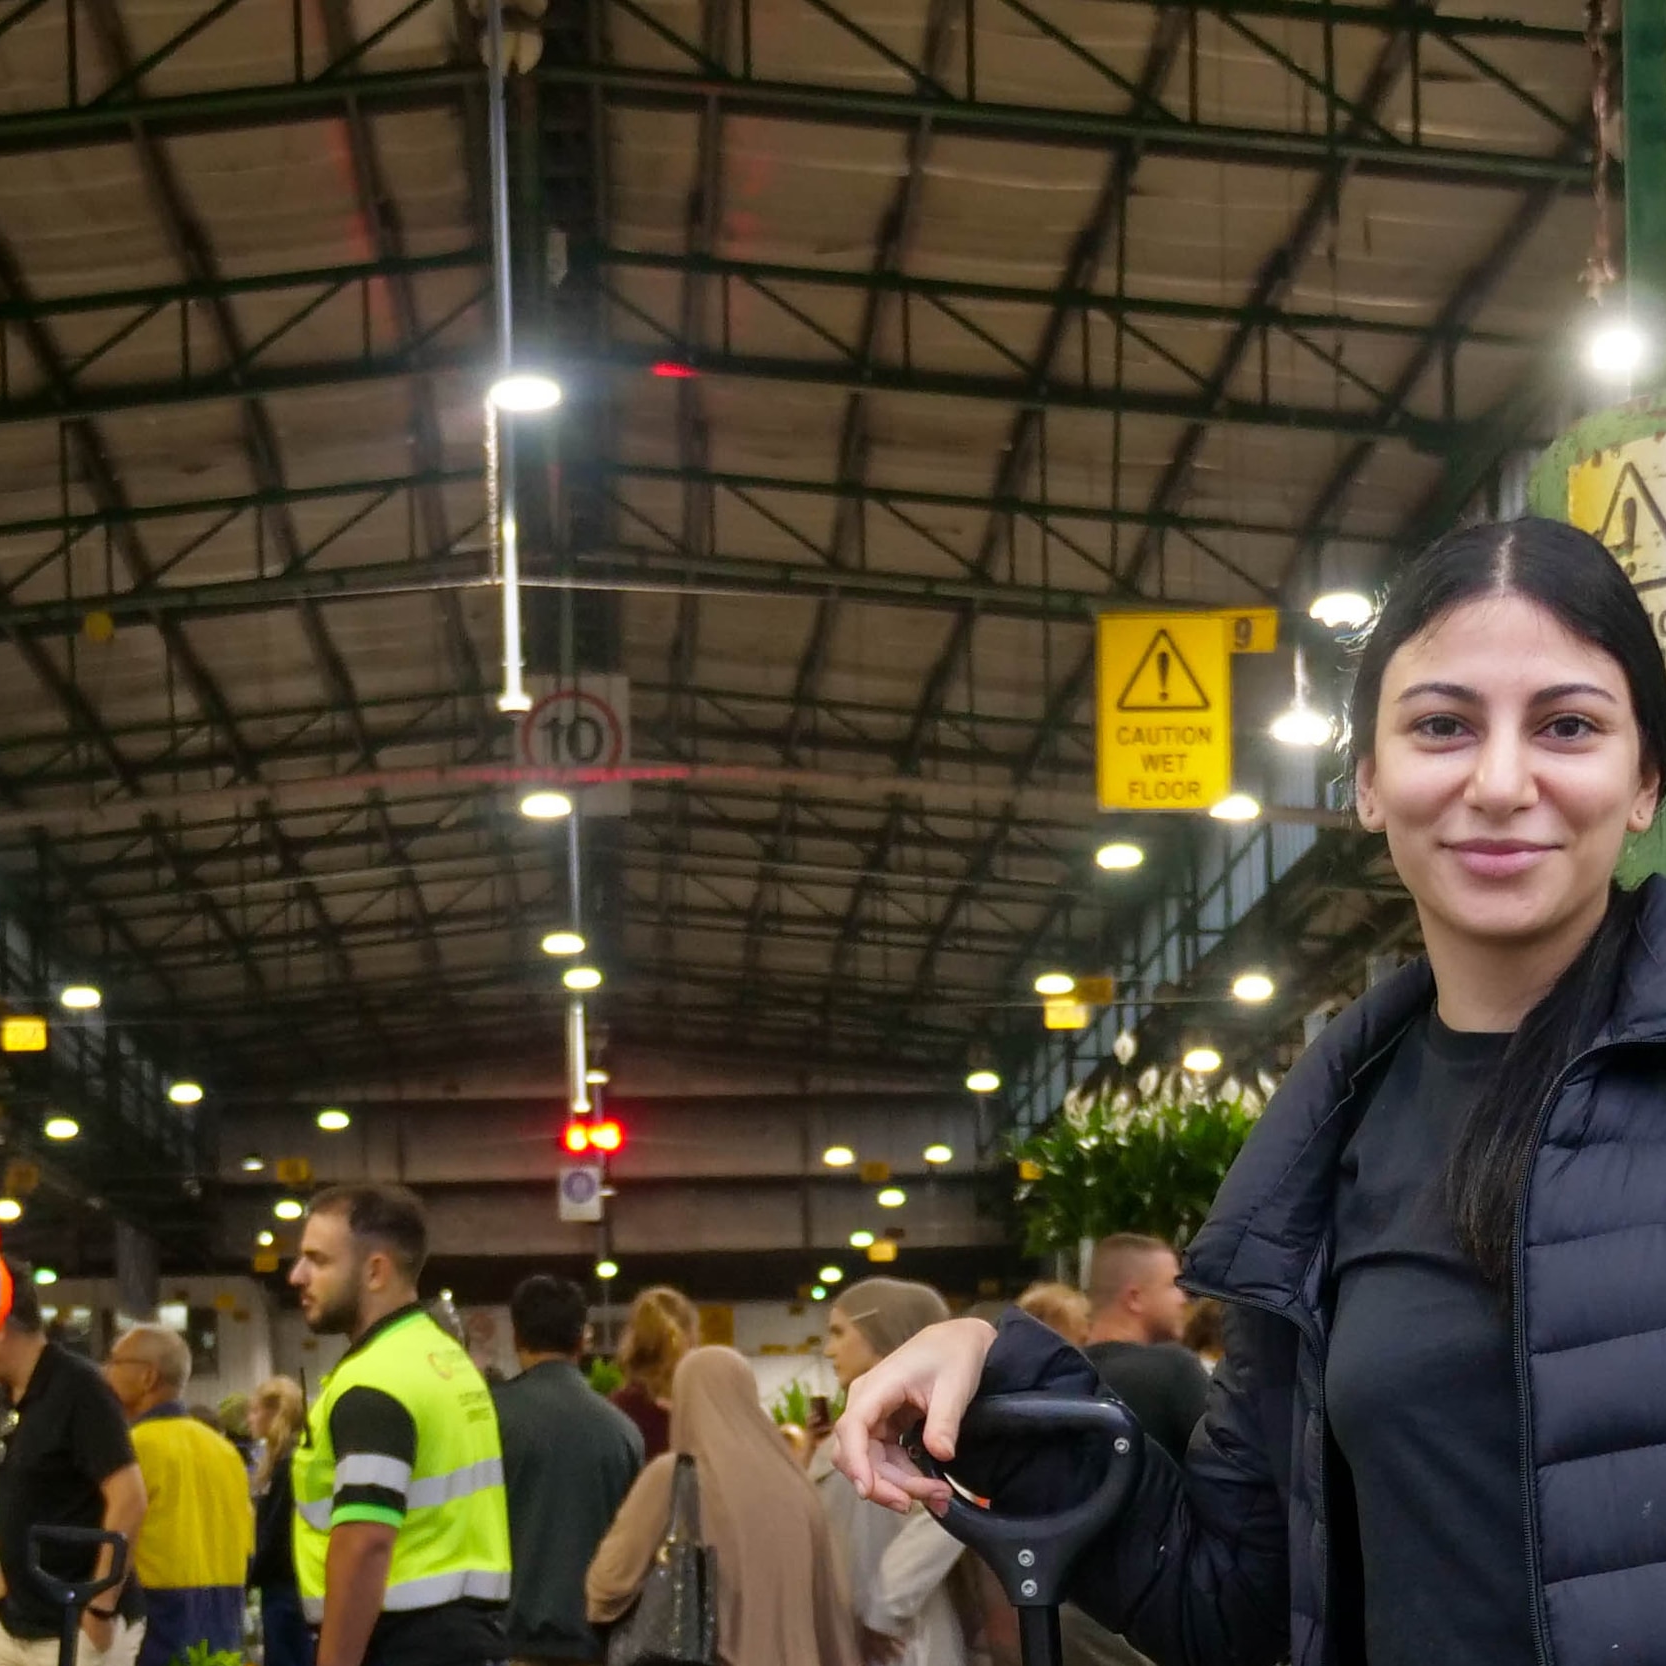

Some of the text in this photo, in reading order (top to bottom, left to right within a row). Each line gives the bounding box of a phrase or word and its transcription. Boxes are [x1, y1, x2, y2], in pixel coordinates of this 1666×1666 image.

[538, 715, 604, 763] 10
[1116, 725, 1212, 745] CAUTION
[1140, 753, 1188, 773] WET
[1128, 780, 1202, 801] FLOOR
